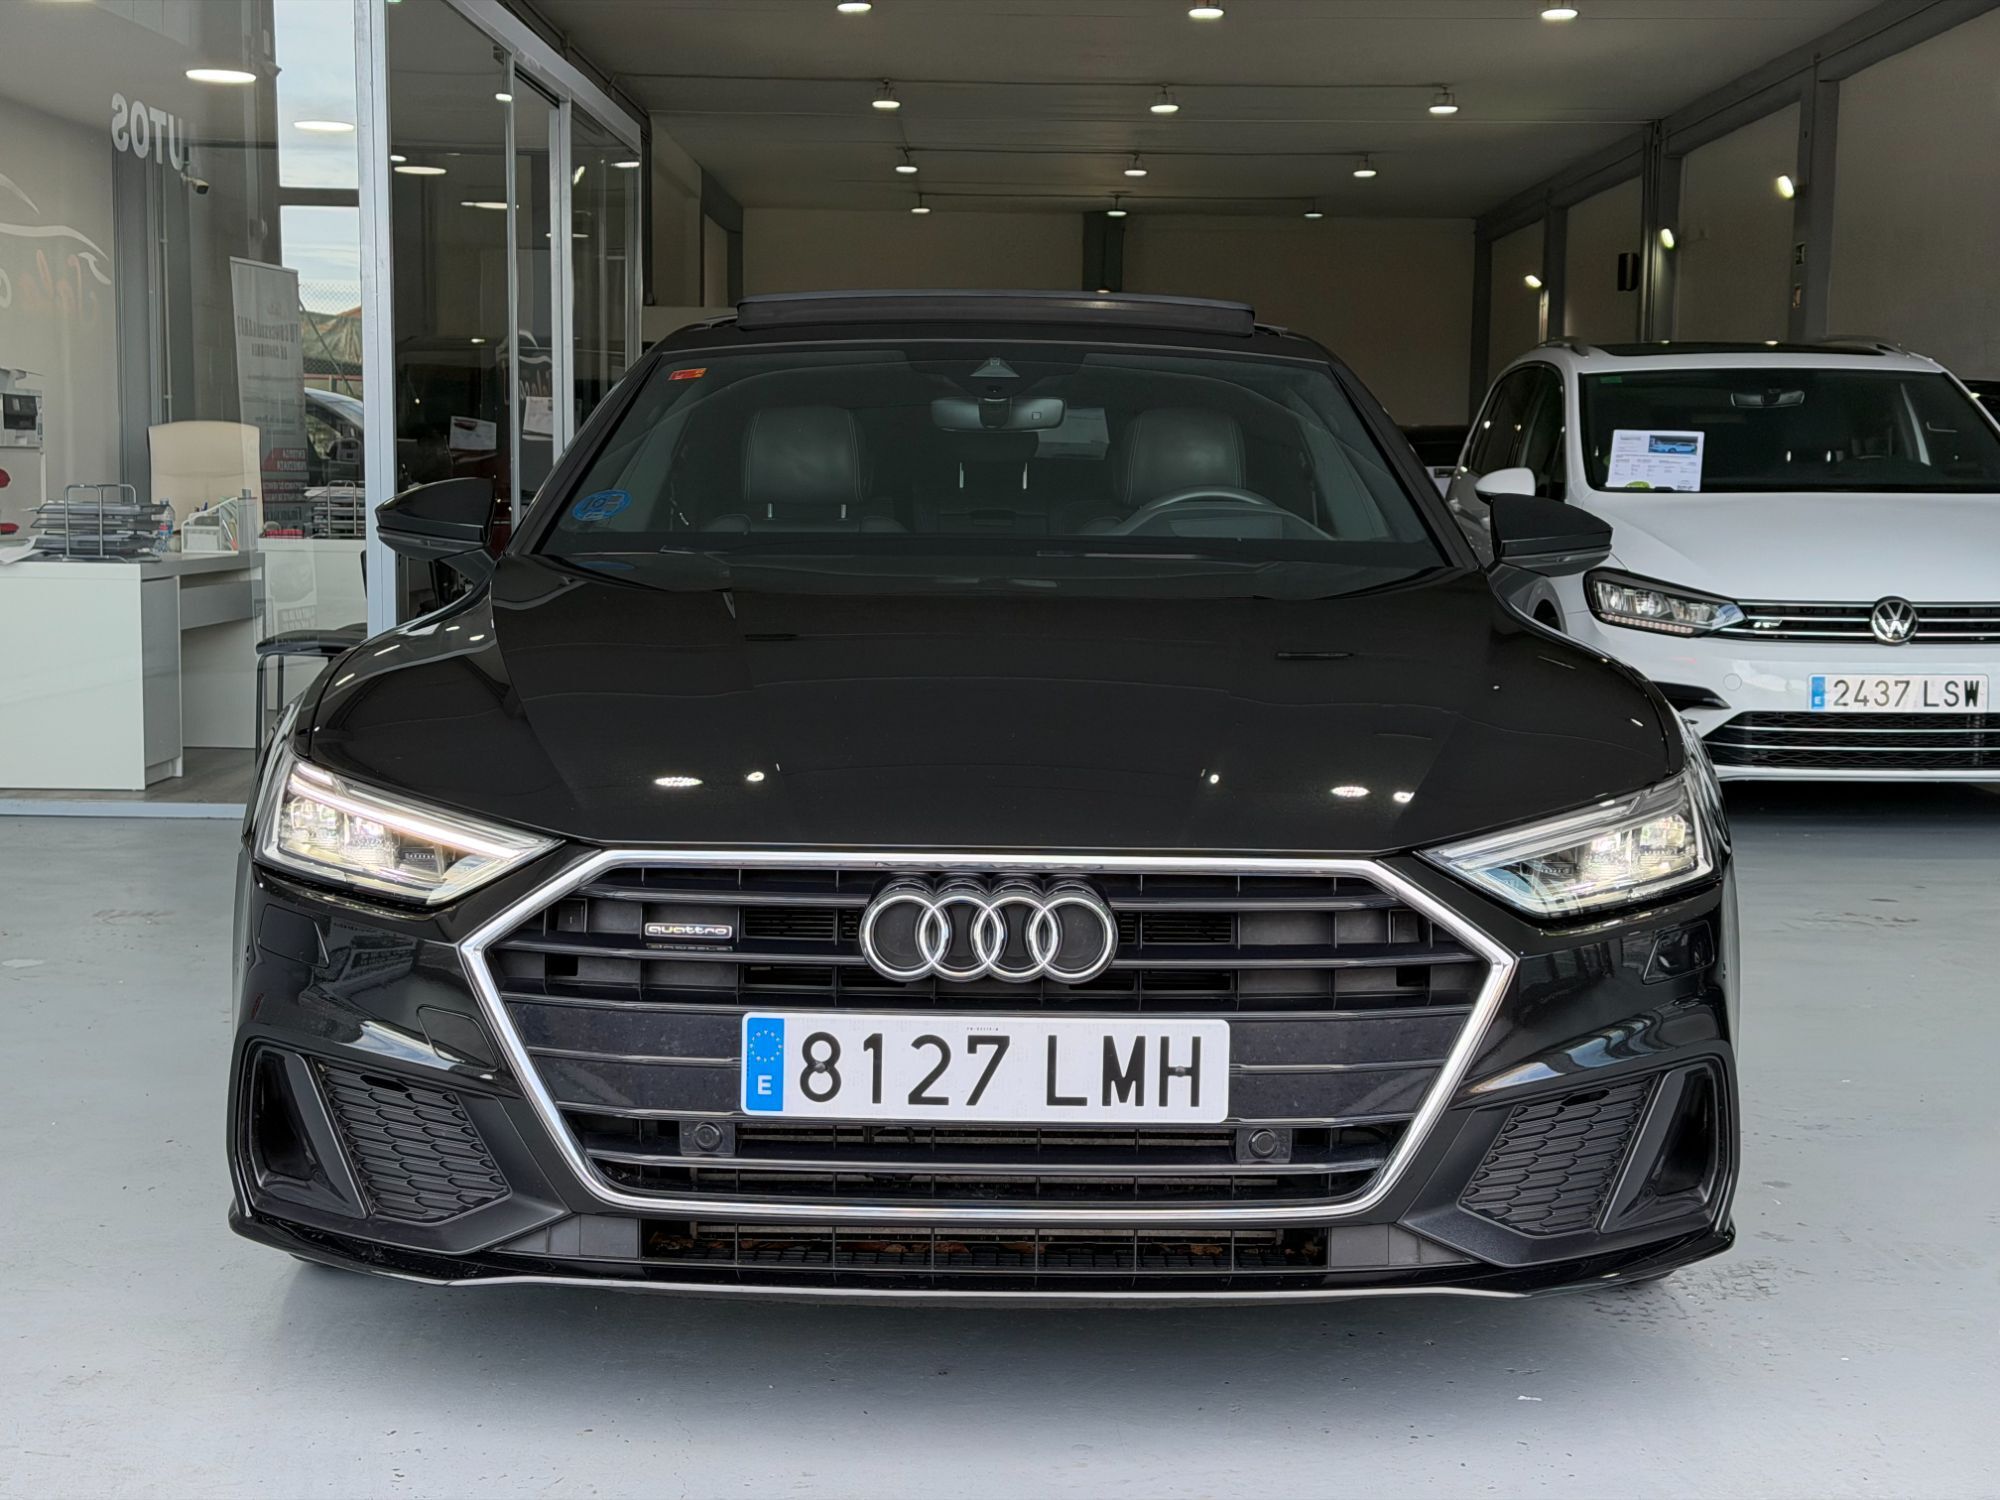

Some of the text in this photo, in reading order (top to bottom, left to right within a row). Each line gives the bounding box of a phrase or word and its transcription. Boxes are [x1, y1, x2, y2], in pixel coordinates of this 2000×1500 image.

[1833, 680, 1980, 708] 2437 LSW
[648, 925, 728, 936] quattro
[800, 1031, 1202, 1108] 8127 LMH
[757, 1074, 773, 1096] E
